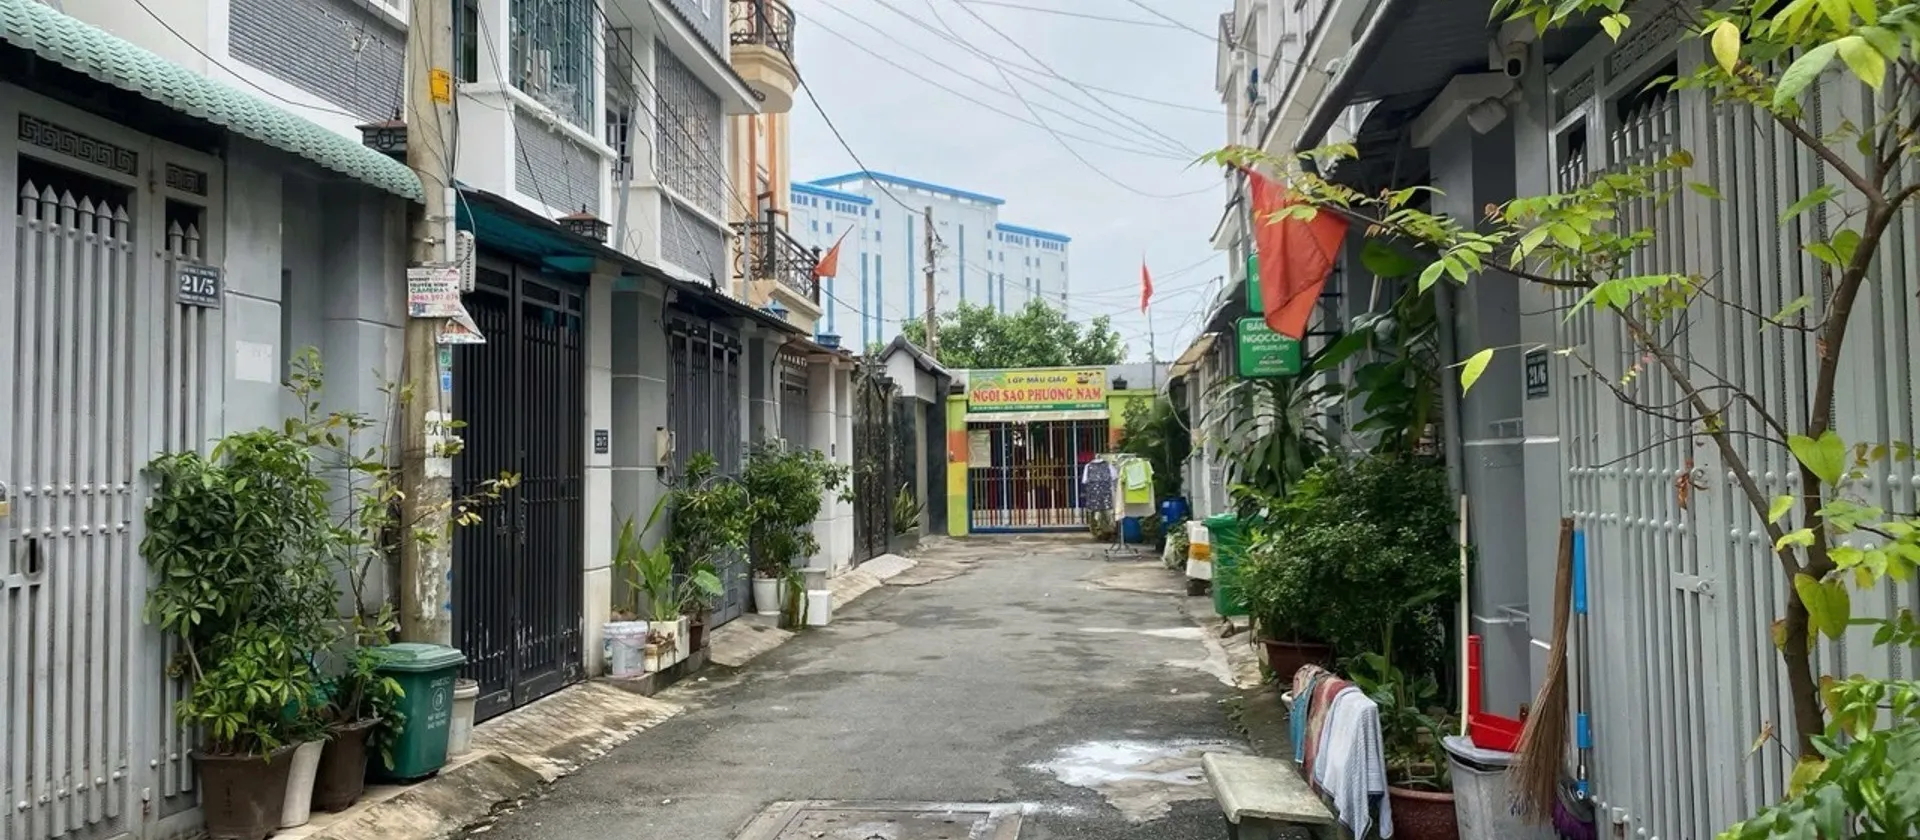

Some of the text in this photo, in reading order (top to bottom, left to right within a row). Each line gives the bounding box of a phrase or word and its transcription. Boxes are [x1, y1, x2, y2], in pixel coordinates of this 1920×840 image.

[181, 274, 215, 296] 21/5
[1529, 363, 1547, 385] 21/6
[1003, 388, 1025, 402] SAO
[1076, 386, 1101, 400] NAM
